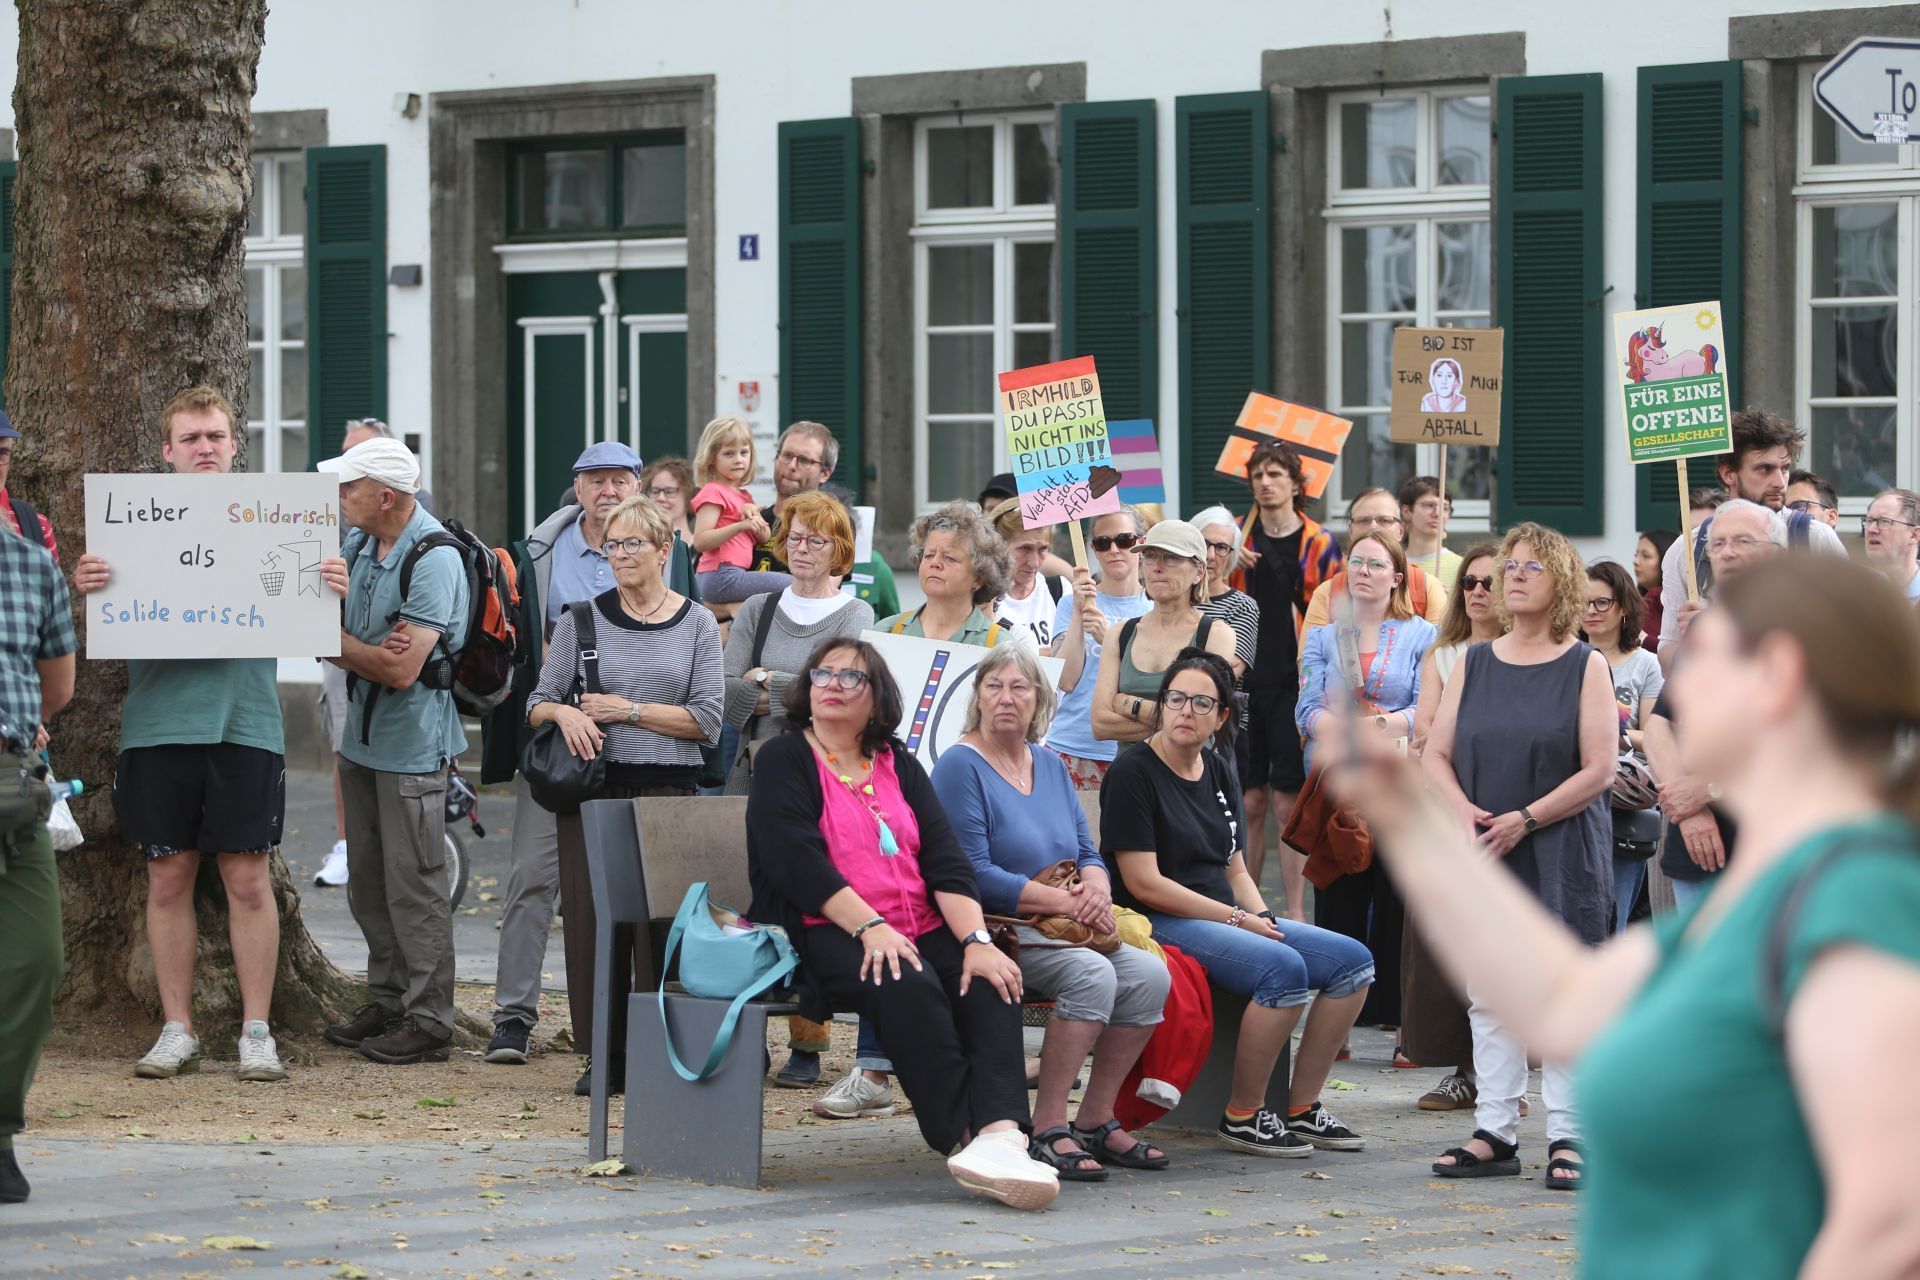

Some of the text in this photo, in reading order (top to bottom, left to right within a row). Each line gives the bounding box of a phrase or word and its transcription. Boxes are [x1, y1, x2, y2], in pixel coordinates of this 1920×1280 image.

[1885, 68, 1917, 114] To
[742, 237, 753, 258] 4
[1452, 337, 1475, 351] IST
[1008, 378, 1093, 411] IRMHILD
[1470, 375, 1498, 390] MICH
[1629, 382, 1722, 409] FÜR EINE
[1011, 398, 1098, 431] DU PASST
[1243, 391, 1352, 455] FCK
[1422, 418, 1483, 438] ABFALL
[1632, 404, 1724, 432] OFFENE
[1014, 420, 1105, 452] NICHT INS
[1633, 427, 1725, 447] GESELLSCHAFT
[1022, 475, 1061, 521] Vielfalt
[1056, 470, 1079, 506] statt
[105, 491, 338, 526] Lieber Solidarisch
[179, 543, 215, 568] als
[101, 600, 265, 627] Solide arisch
